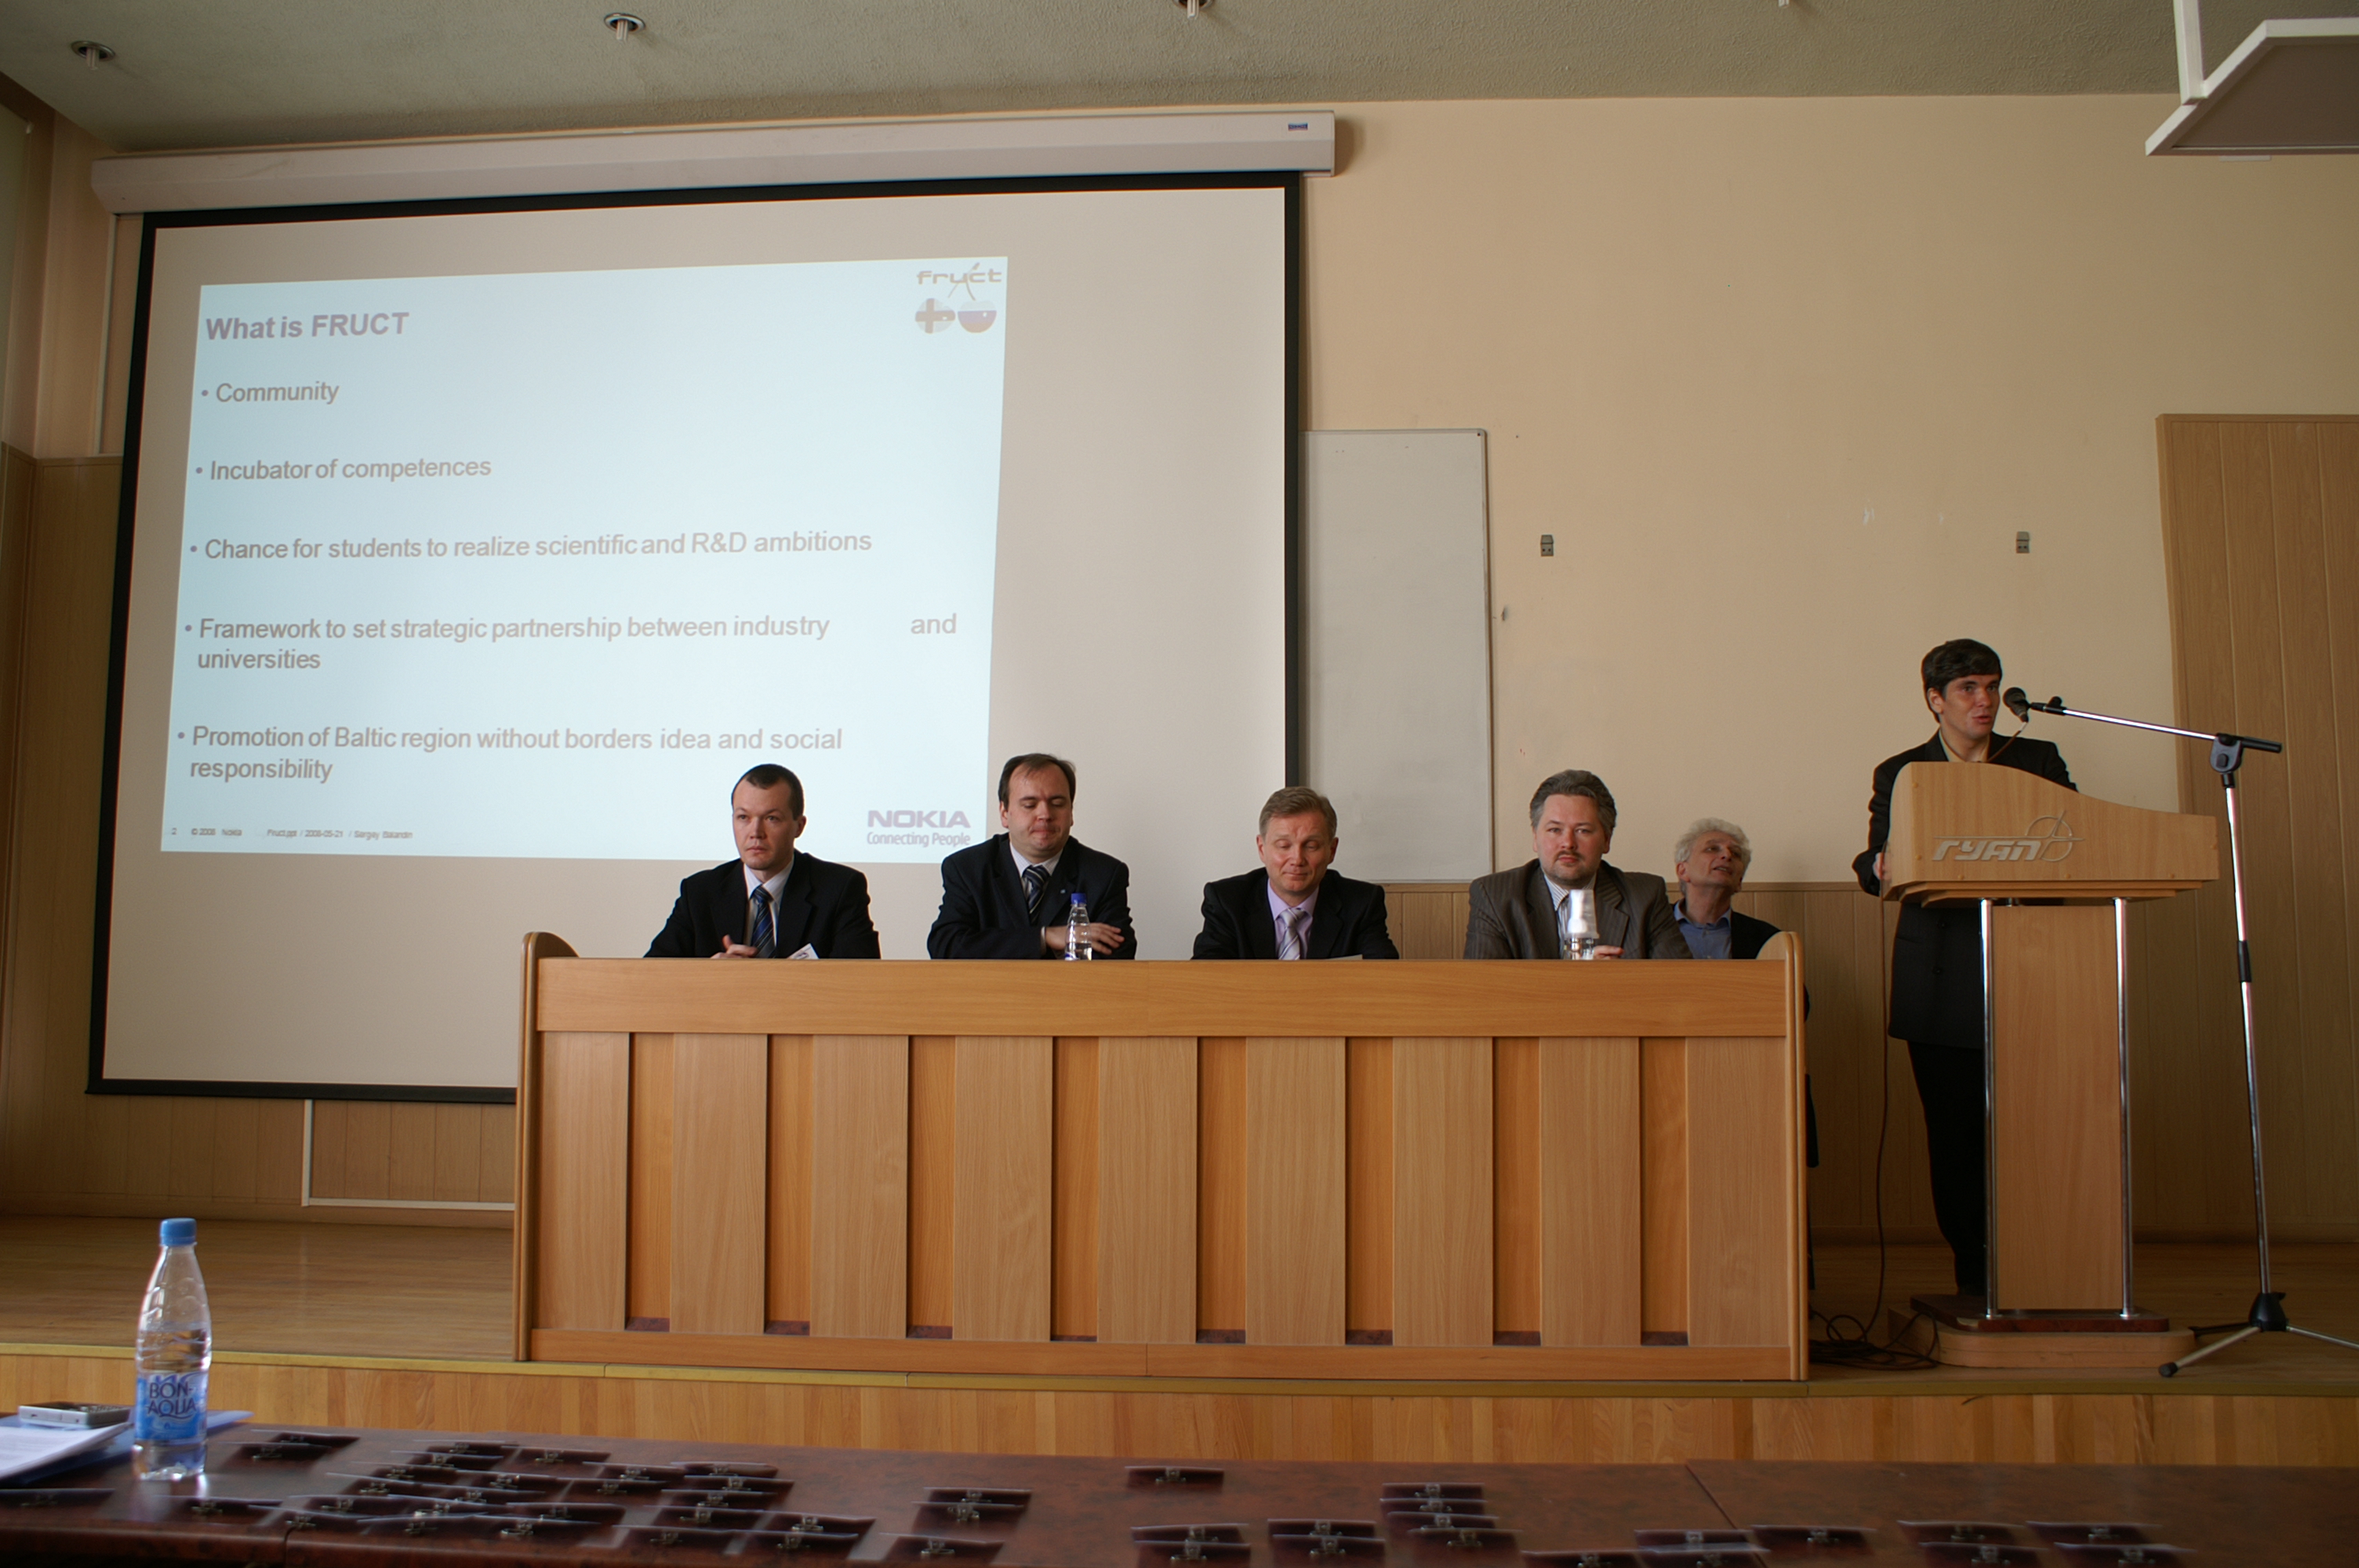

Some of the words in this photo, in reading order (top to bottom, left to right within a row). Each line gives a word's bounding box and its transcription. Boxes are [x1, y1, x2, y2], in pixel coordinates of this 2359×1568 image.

[917, 269, 1002, 285] fruct
[205, 317, 276, 340] What
[280, 315, 304, 338] is
[311, 311, 410, 337] FRUCT
[216, 381, 340, 405] Community
[210, 459, 312, 481] Incubator
[315, 459, 339, 479] of
[342, 459, 492, 482] competences
[205, 539, 289, 559] Chance
[293, 538, 322, 558] for
[328, 538, 422, 558] students
[427, 538, 448, 557] to
[453, 536, 530, 557] realize
[535, 534, 638, 556] scientific
[641, 533, 685, 554] and
[691, 532, 747, 554] R&D
[754, 531, 872, 552] ambitions
[199, 618, 321, 639] Framework
[325, 619, 346, 639] to
[353, 619, 386, 639] set
[391, 618, 488, 643] strategic
[492, 617, 622, 643] partnership
[627, 617, 727, 637] between
[733, 615, 830, 641] industry
[911, 613, 957, 635] and
[198, 648, 321, 669] universities
[193, 725, 304, 747] Promotion
[308, 727, 331, 747] of
[335, 727, 397, 747] Baltic
[402, 728, 471, 753] region
[477, 728, 560, 748] without
[565, 728, 652, 749] borders
[660, 728, 711, 749] idea
[718, 728, 763, 750] and
[770, 728, 842, 750] social
[191, 759, 333, 784] responsibility
[867, 810, 971, 829] NOKIA
[867, 832, 929, 847] Connecting
[932, 832, 971, 848] People
[147, 1398, 197, 1419] AQUA
